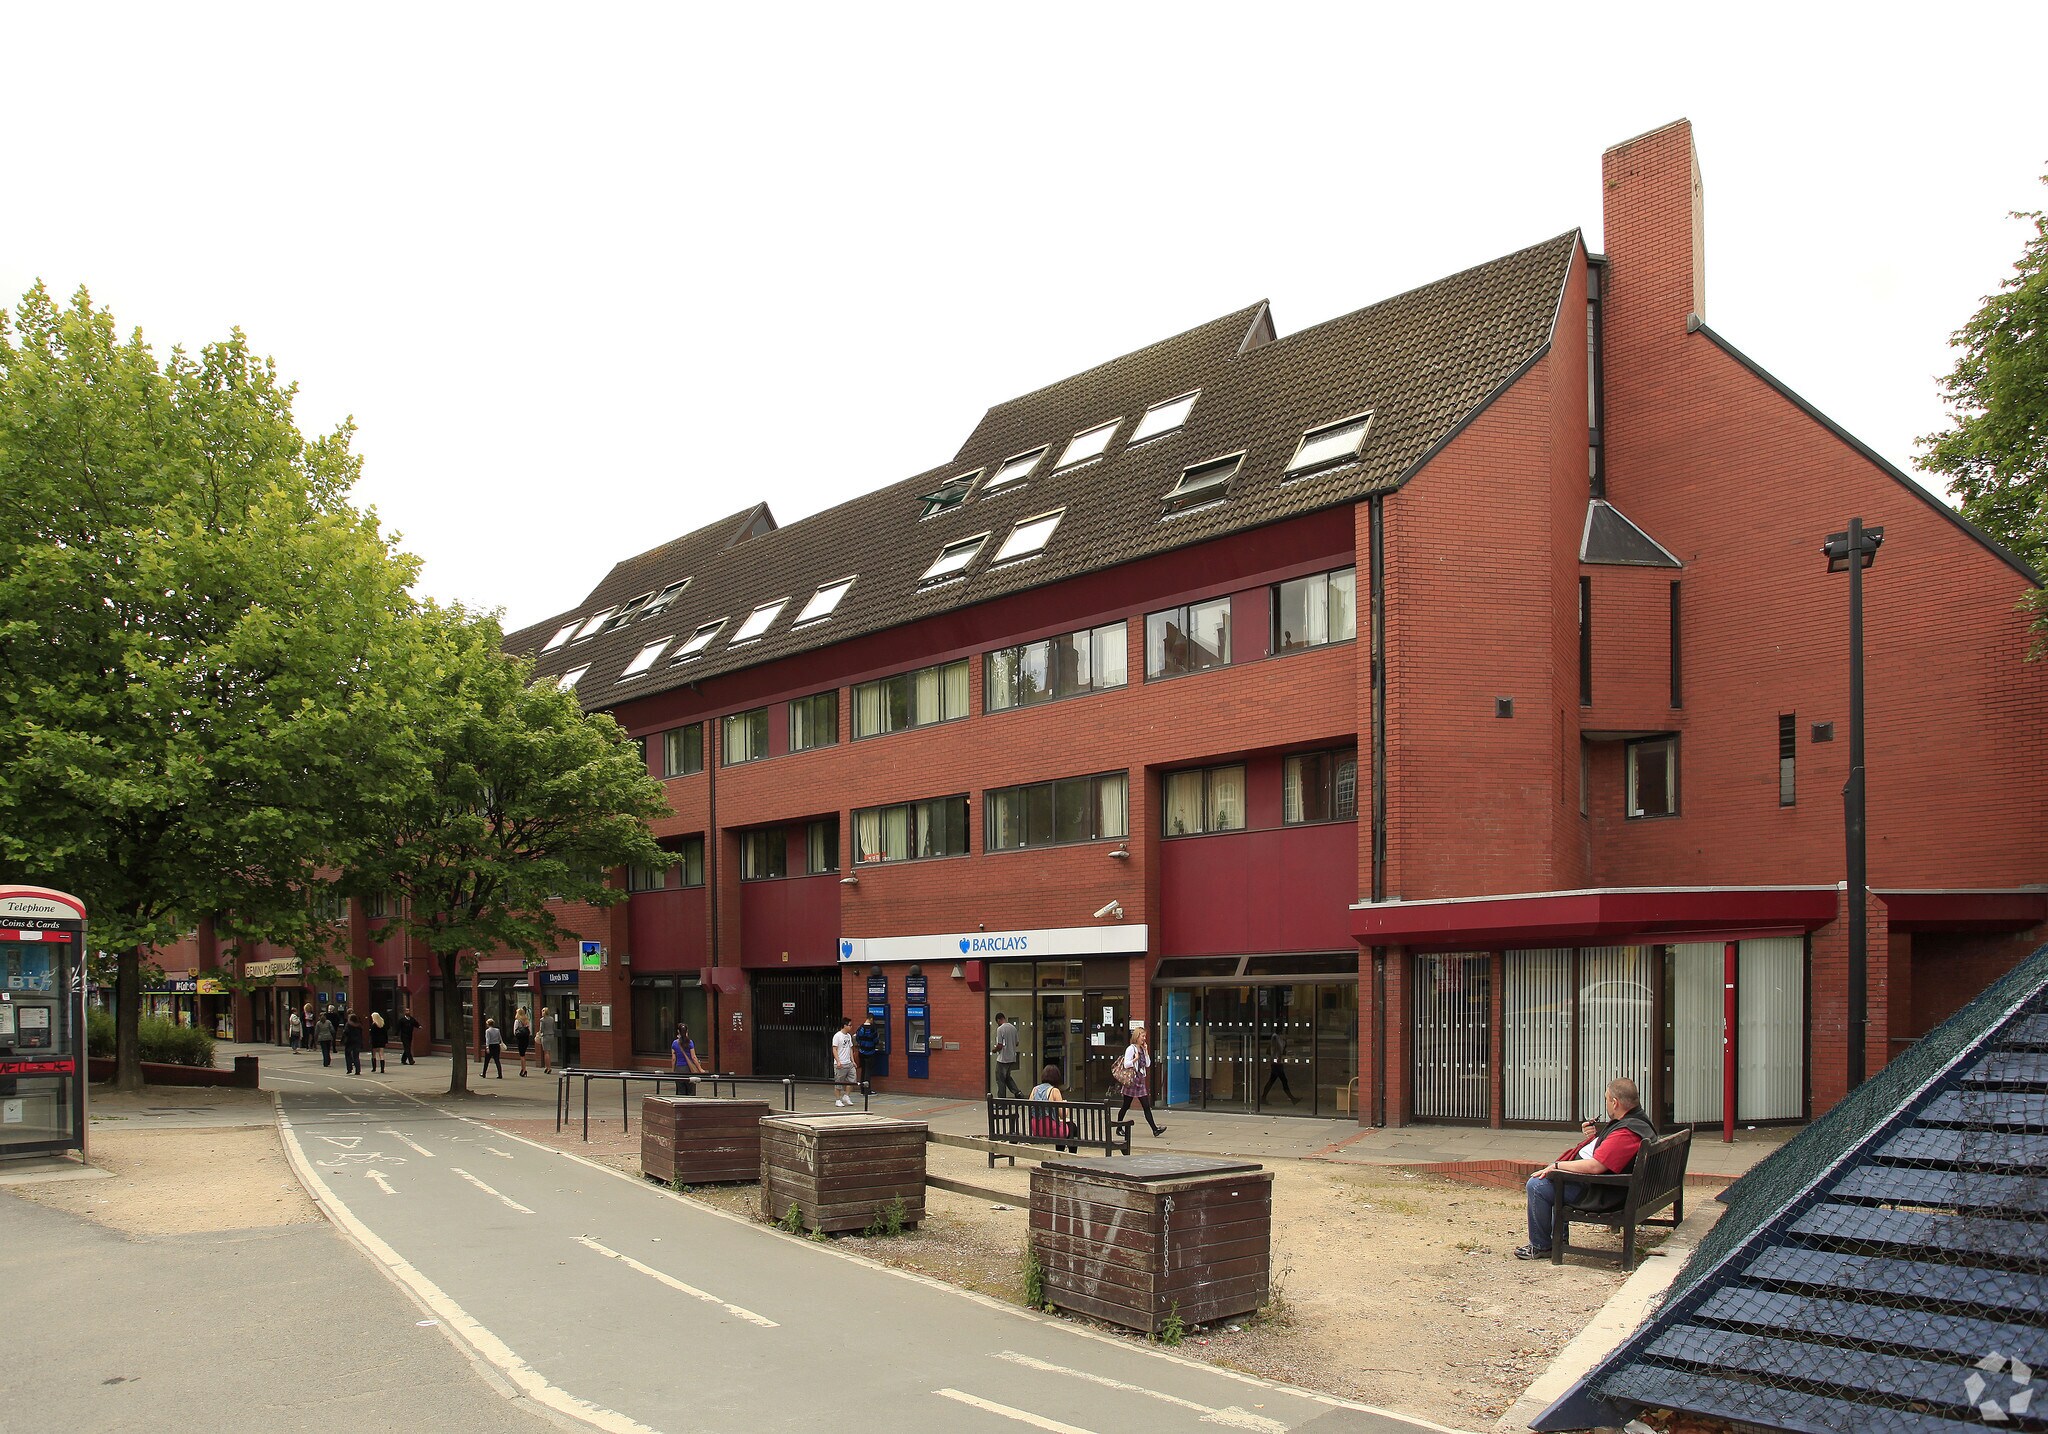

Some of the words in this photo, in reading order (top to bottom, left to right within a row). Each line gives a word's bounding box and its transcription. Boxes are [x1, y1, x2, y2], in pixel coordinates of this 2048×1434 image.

[8, 902, 56, 913] Telephone
[2, 919, 25, 928] Coins
[26, 920, 34, 928] &
[36, 920, 60, 929] Cards
[973, 936, 1027, 951] BARCLAYS
[245, 965, 263, 976] GEMINI
[8, 975, 40, 989] BT
[549, 973, 561, 983] Lloyds
